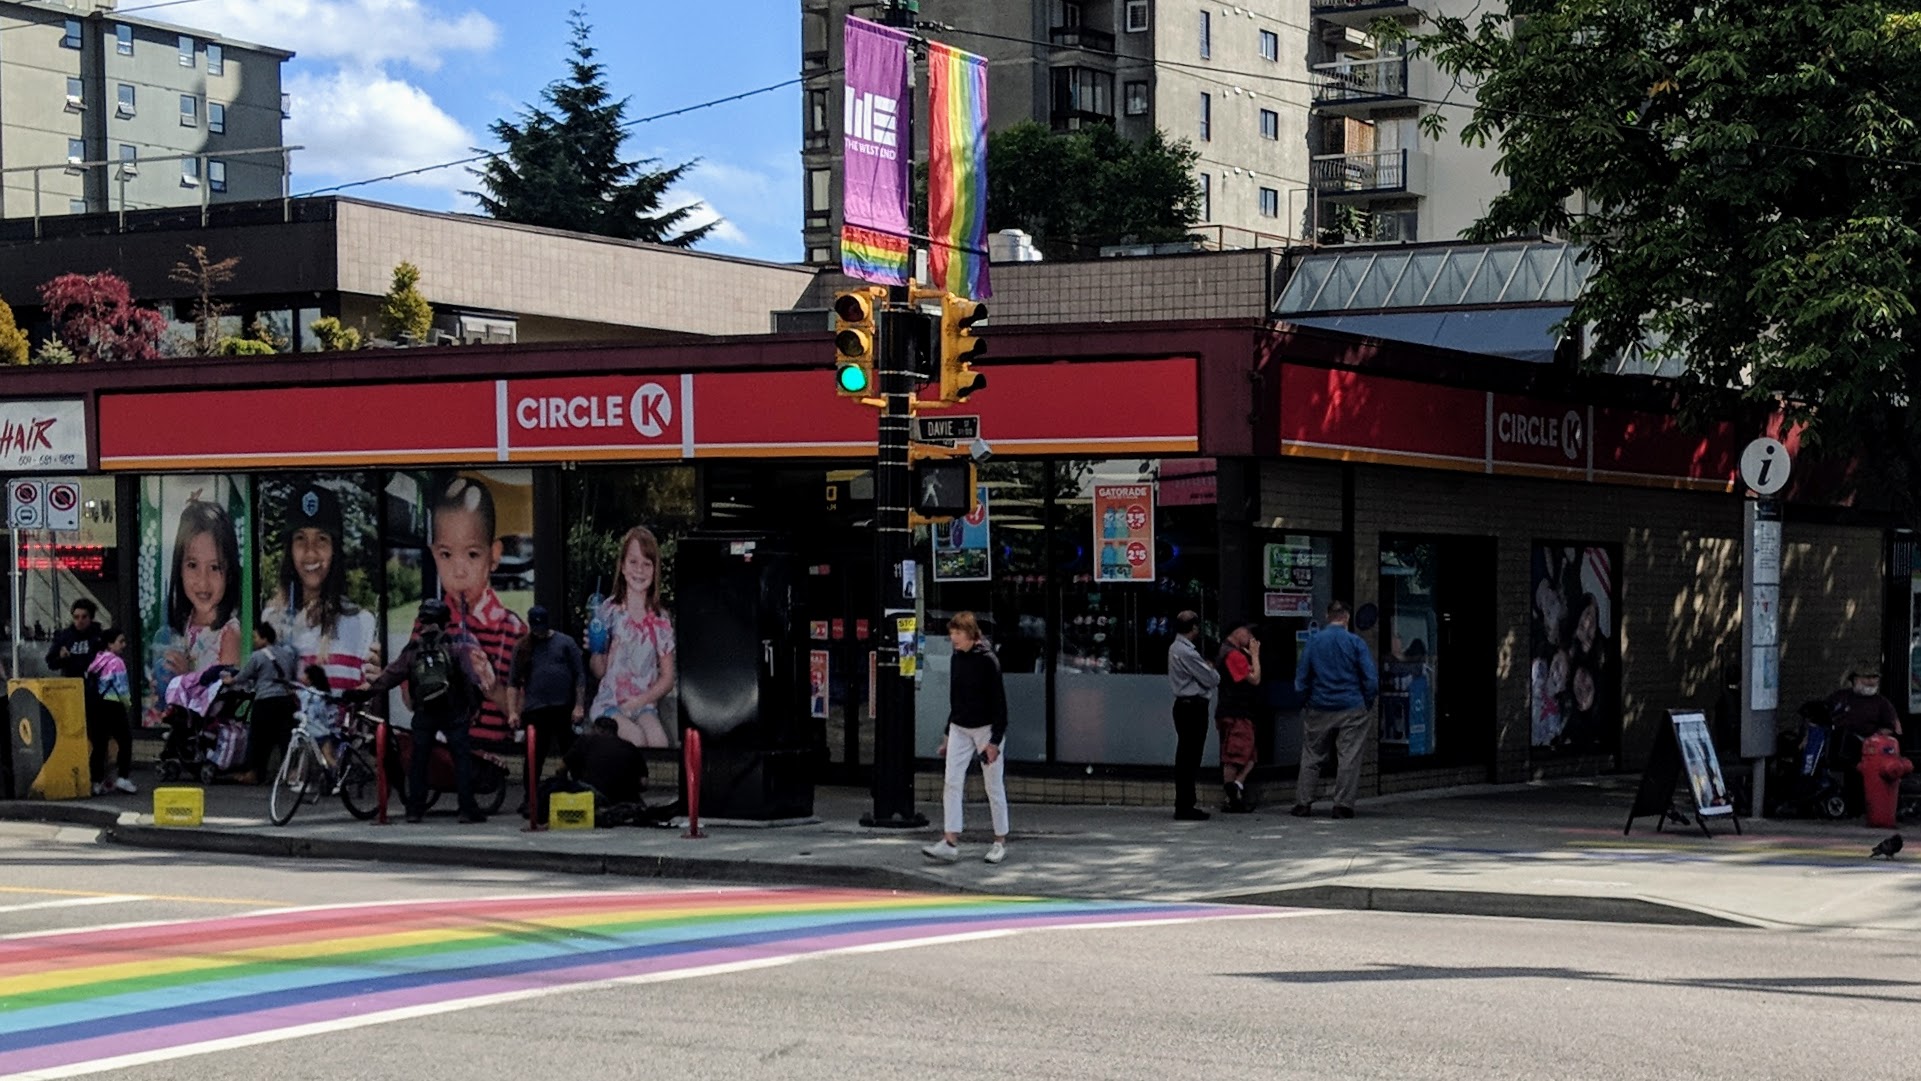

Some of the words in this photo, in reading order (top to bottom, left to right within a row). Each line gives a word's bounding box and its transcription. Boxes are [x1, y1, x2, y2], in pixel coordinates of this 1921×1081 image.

[845, 137, 859, 151] THE
[859, 142, 880, 156] WEST
[880, 147, 897, 160] END
[516, 396, 624, 429] CIRCLE
[928, 421, 954, 436] DAVIE
[1498, 412, 1558, 447] CIRCLE
[1098, 487, 1147, 498] GATORADE
